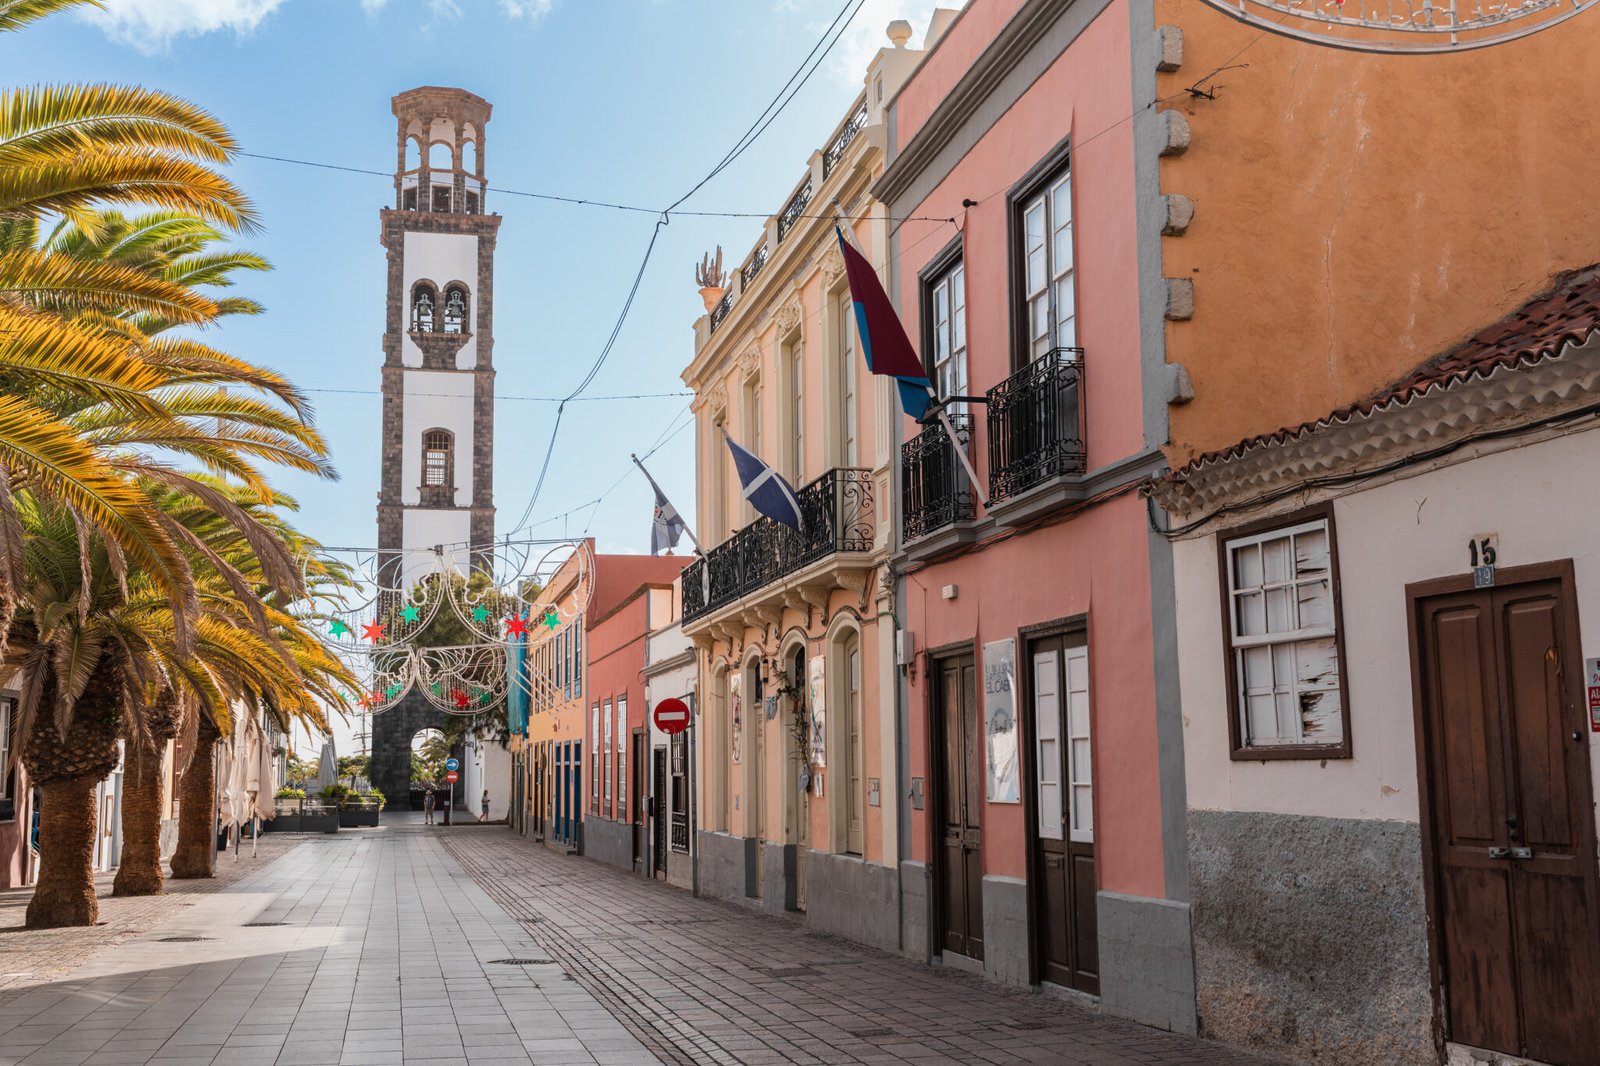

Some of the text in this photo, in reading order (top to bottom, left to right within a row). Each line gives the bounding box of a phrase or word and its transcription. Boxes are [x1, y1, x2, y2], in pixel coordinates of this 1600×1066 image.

[1469, 537, 1496, 566] 15
[1477, 568, 1491, 585] 19
[995, 679, 1011, 693] CAB
